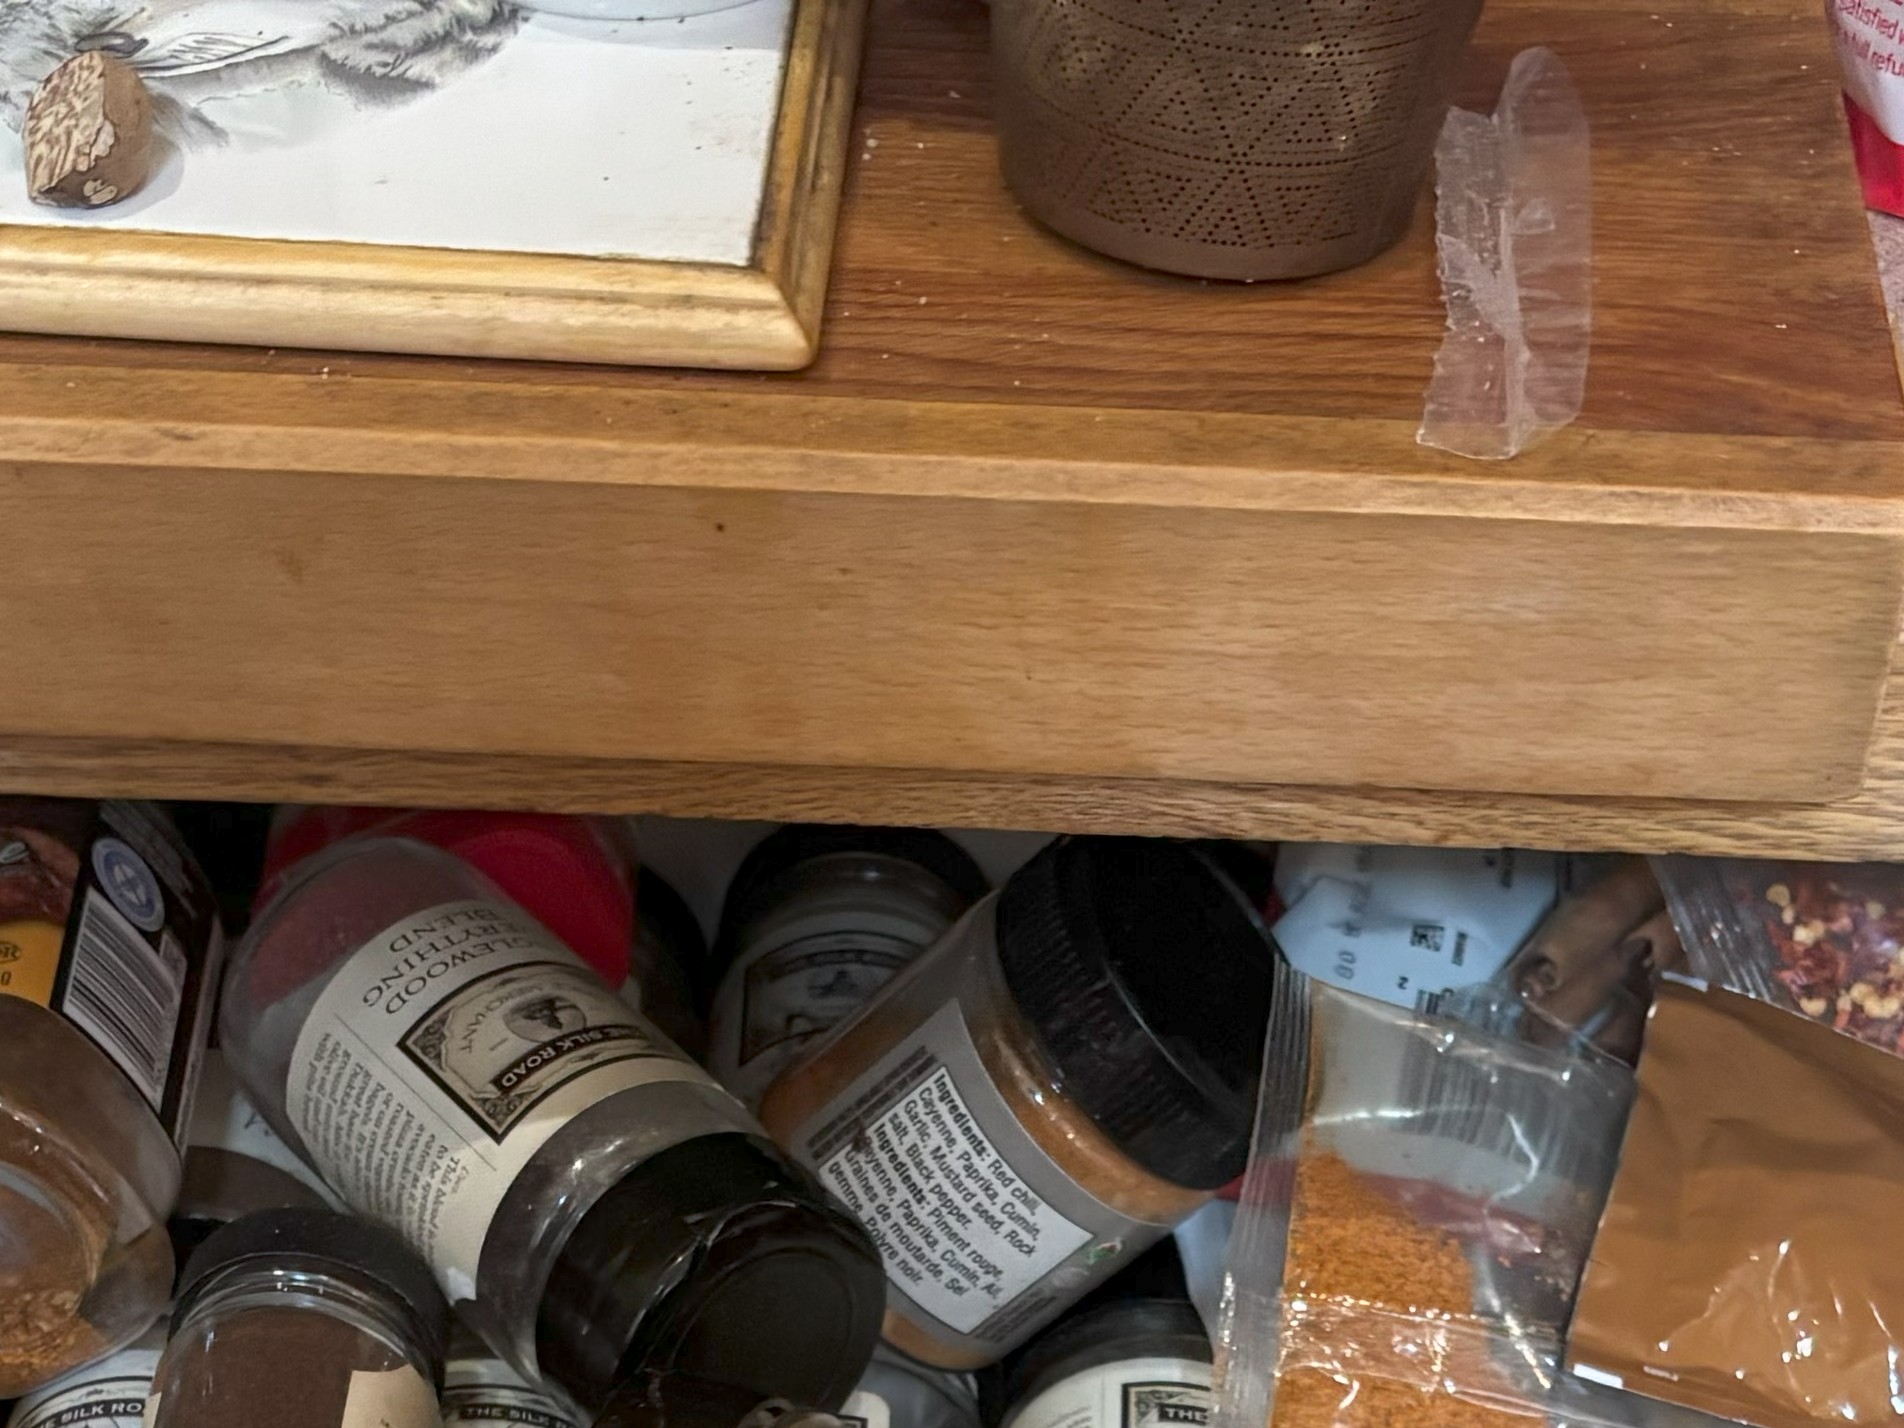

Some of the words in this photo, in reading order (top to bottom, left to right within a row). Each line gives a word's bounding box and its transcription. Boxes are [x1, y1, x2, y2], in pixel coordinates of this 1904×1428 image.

[389, 907, 499, 954] BLEND
[500, 1048, 557, 1088] ROAD
[933, 1073, 992, 1162] Ingredients:
[905, 1142, 932, 1188] Black
[928, 1207, 971, 1252] Piment
[61, 1403, 104, 1422] SILK
